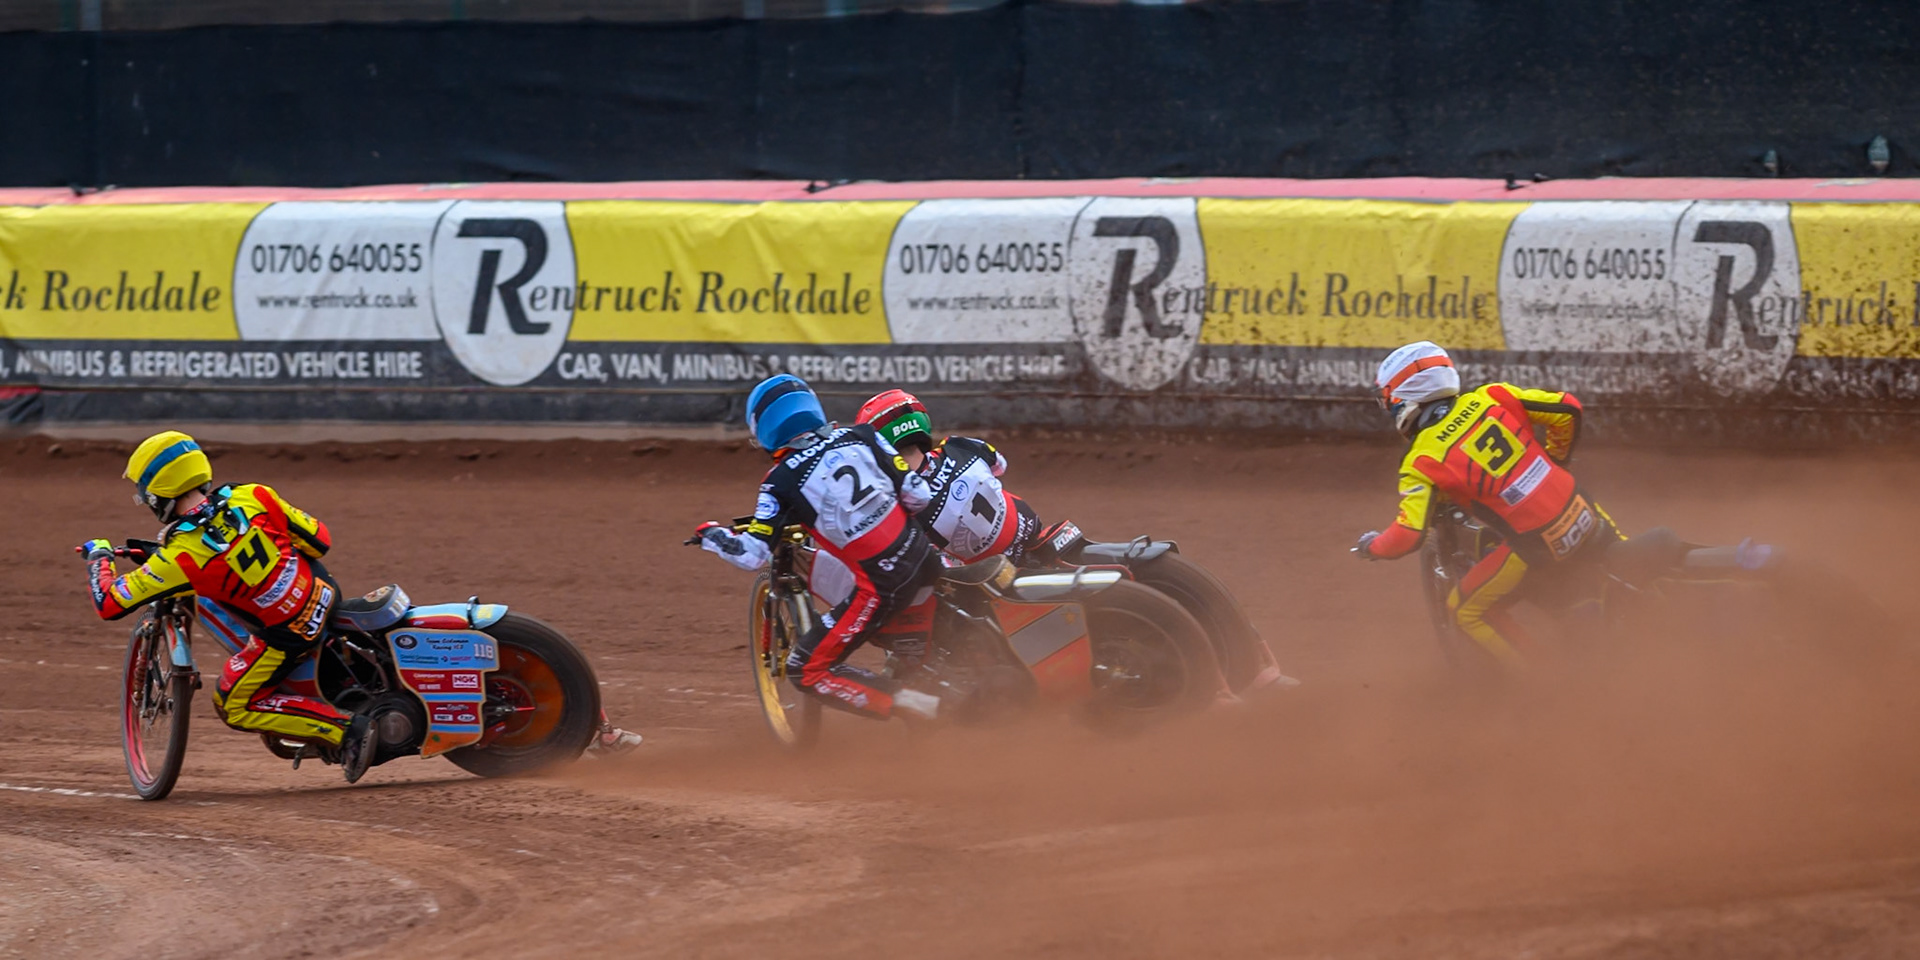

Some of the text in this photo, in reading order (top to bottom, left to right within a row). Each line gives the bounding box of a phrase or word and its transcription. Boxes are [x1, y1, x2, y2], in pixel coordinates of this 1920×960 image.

[250, 243, 424, 274] 01706 640055
[900, 243, 1064, 275] 01706 640055
[1512, 247, 1667, 281] 01706 640055
[40, 270, 221, 312] Rochdale
[694, 271, 872, 315] Rochdale
[1321, 272, 1487, 320] Rochdale
[130, 350, 279, 379] REFRIGERATED
[283, 351, 371, 379] VEHICLE
[374, 351, 424, 379] HIRE
[672, 353, 769, 382] MINIBUS
[787, 354, 931, 383] REFRIGERATED
[933, 355, 1016, 382] VEHICLE
[892, 419, 920, 437] BOLL
[1435, 399, 1482, 443] MORRIS
[1474, 424, 1515, 471] 3
[833, 465, 874, 506] 2
[970, 492, 997, 525] 1
[1558, 509, 1593, 556] JCB
[235, 532, 271, 574] 4
[307, 587, 333, 636] JCB
[473, 643, 494, 659] 118
[453, 675, 477, 683] NGK
